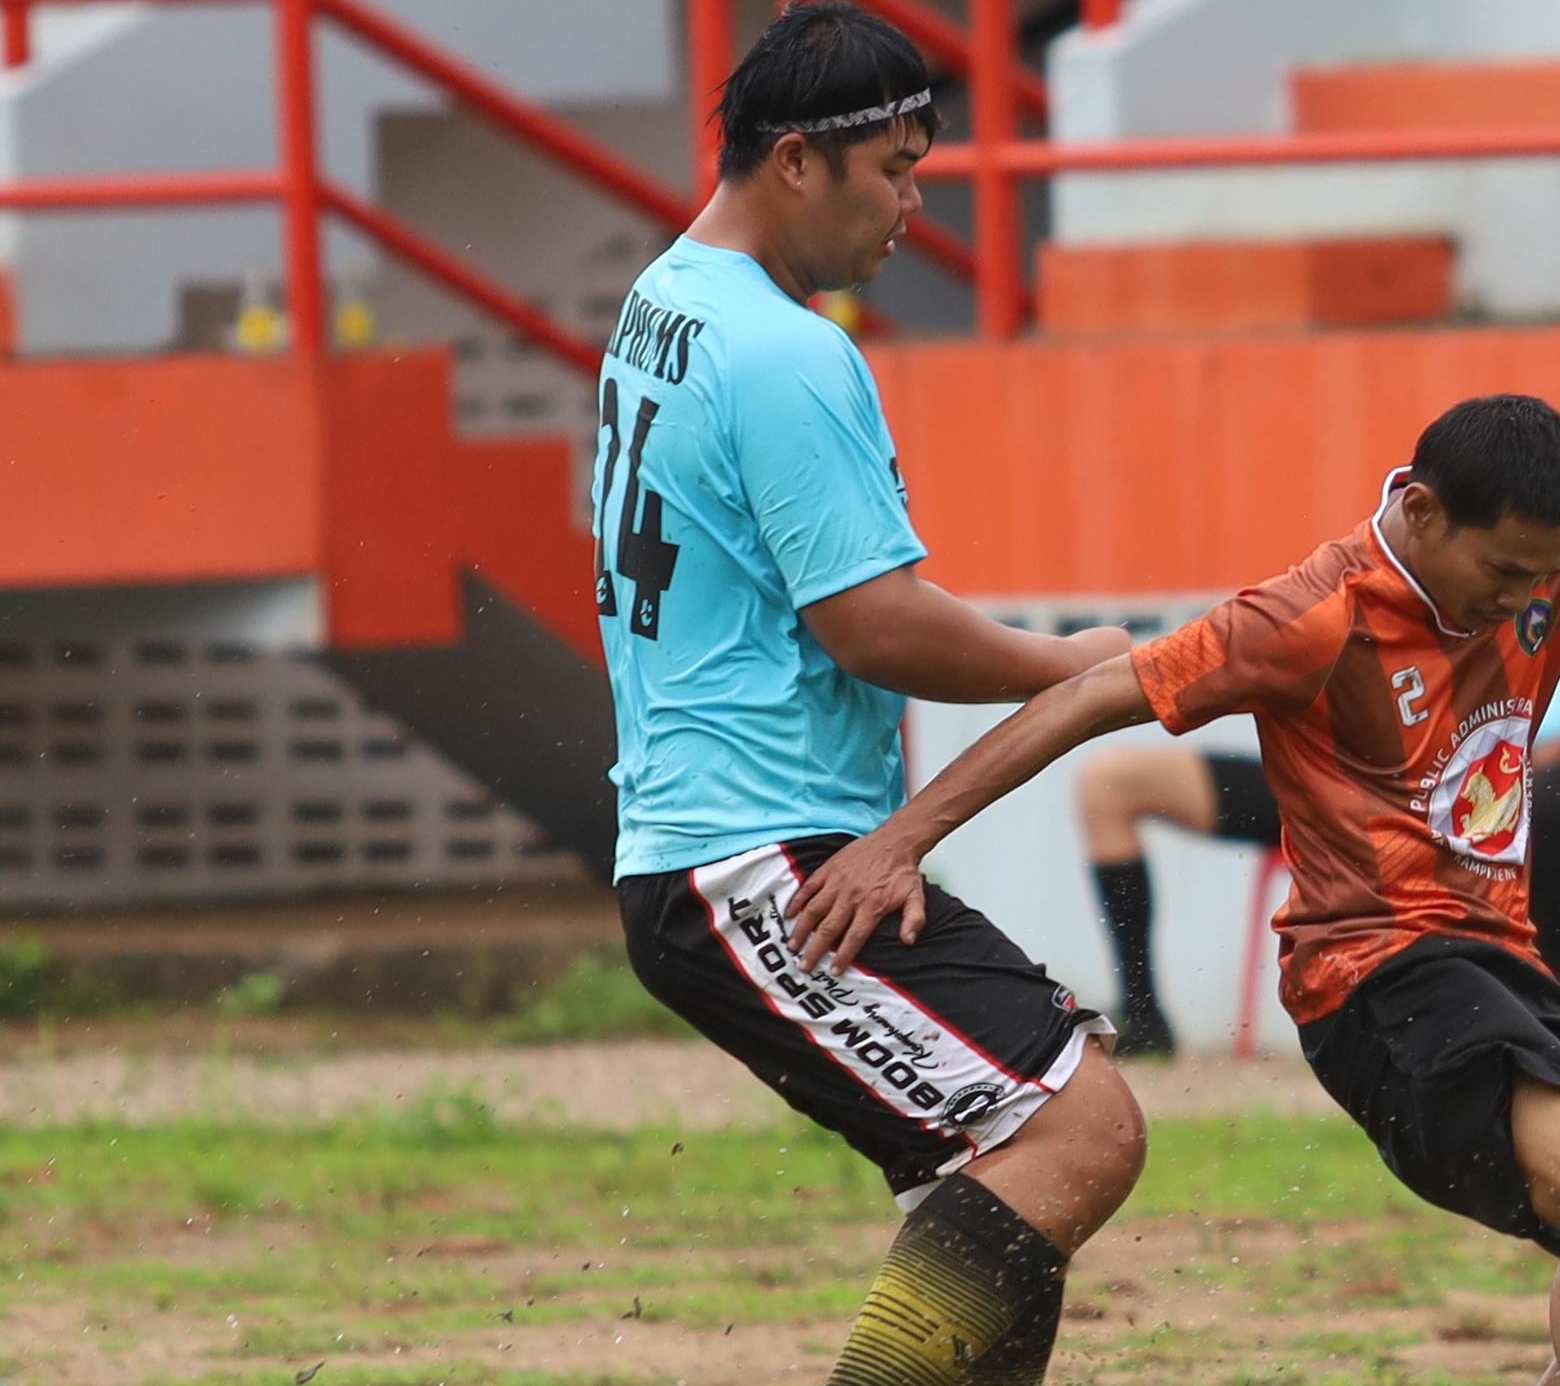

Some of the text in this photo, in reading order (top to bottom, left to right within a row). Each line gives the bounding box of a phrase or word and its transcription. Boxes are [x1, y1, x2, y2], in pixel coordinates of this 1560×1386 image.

[1391, 665, 1429, 727] 2
[1410, 748, 1450, 812] PUBLIC
[728, 896, 945, 1111] BOOM SPORT
[808, 971, 859, 1006] Phet
